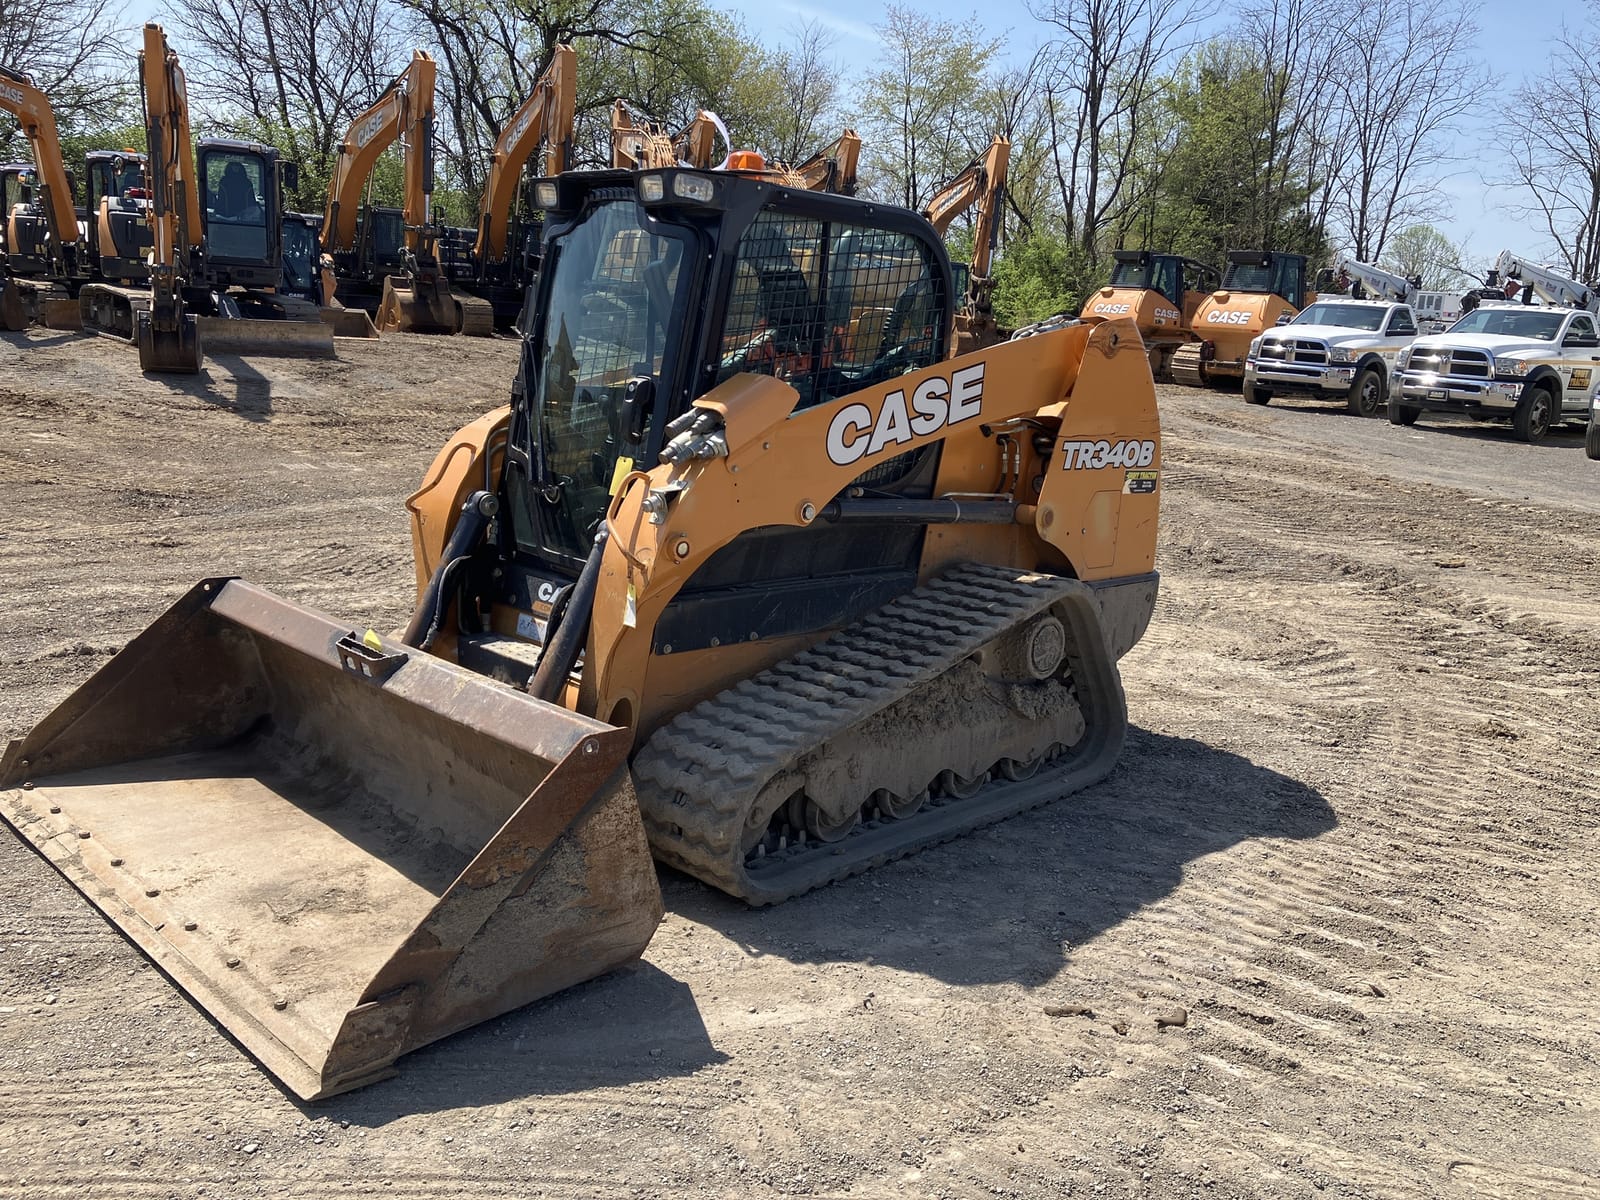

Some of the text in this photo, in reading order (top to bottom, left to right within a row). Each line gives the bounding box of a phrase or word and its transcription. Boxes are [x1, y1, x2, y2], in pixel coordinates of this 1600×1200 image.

[0, 83, 24, 105] CASE
[357, 111, 383, 148] CASE
[506, 110, 529, 153] CASE
[1094, 303, 1131, 314] CASE
[1154, 307, 1180, 319] CASE
[1207, 310, 1253, 325] CASE
[826, 361, 986, 466] CASE
[1062, 439, 1156, 470] TR340B
